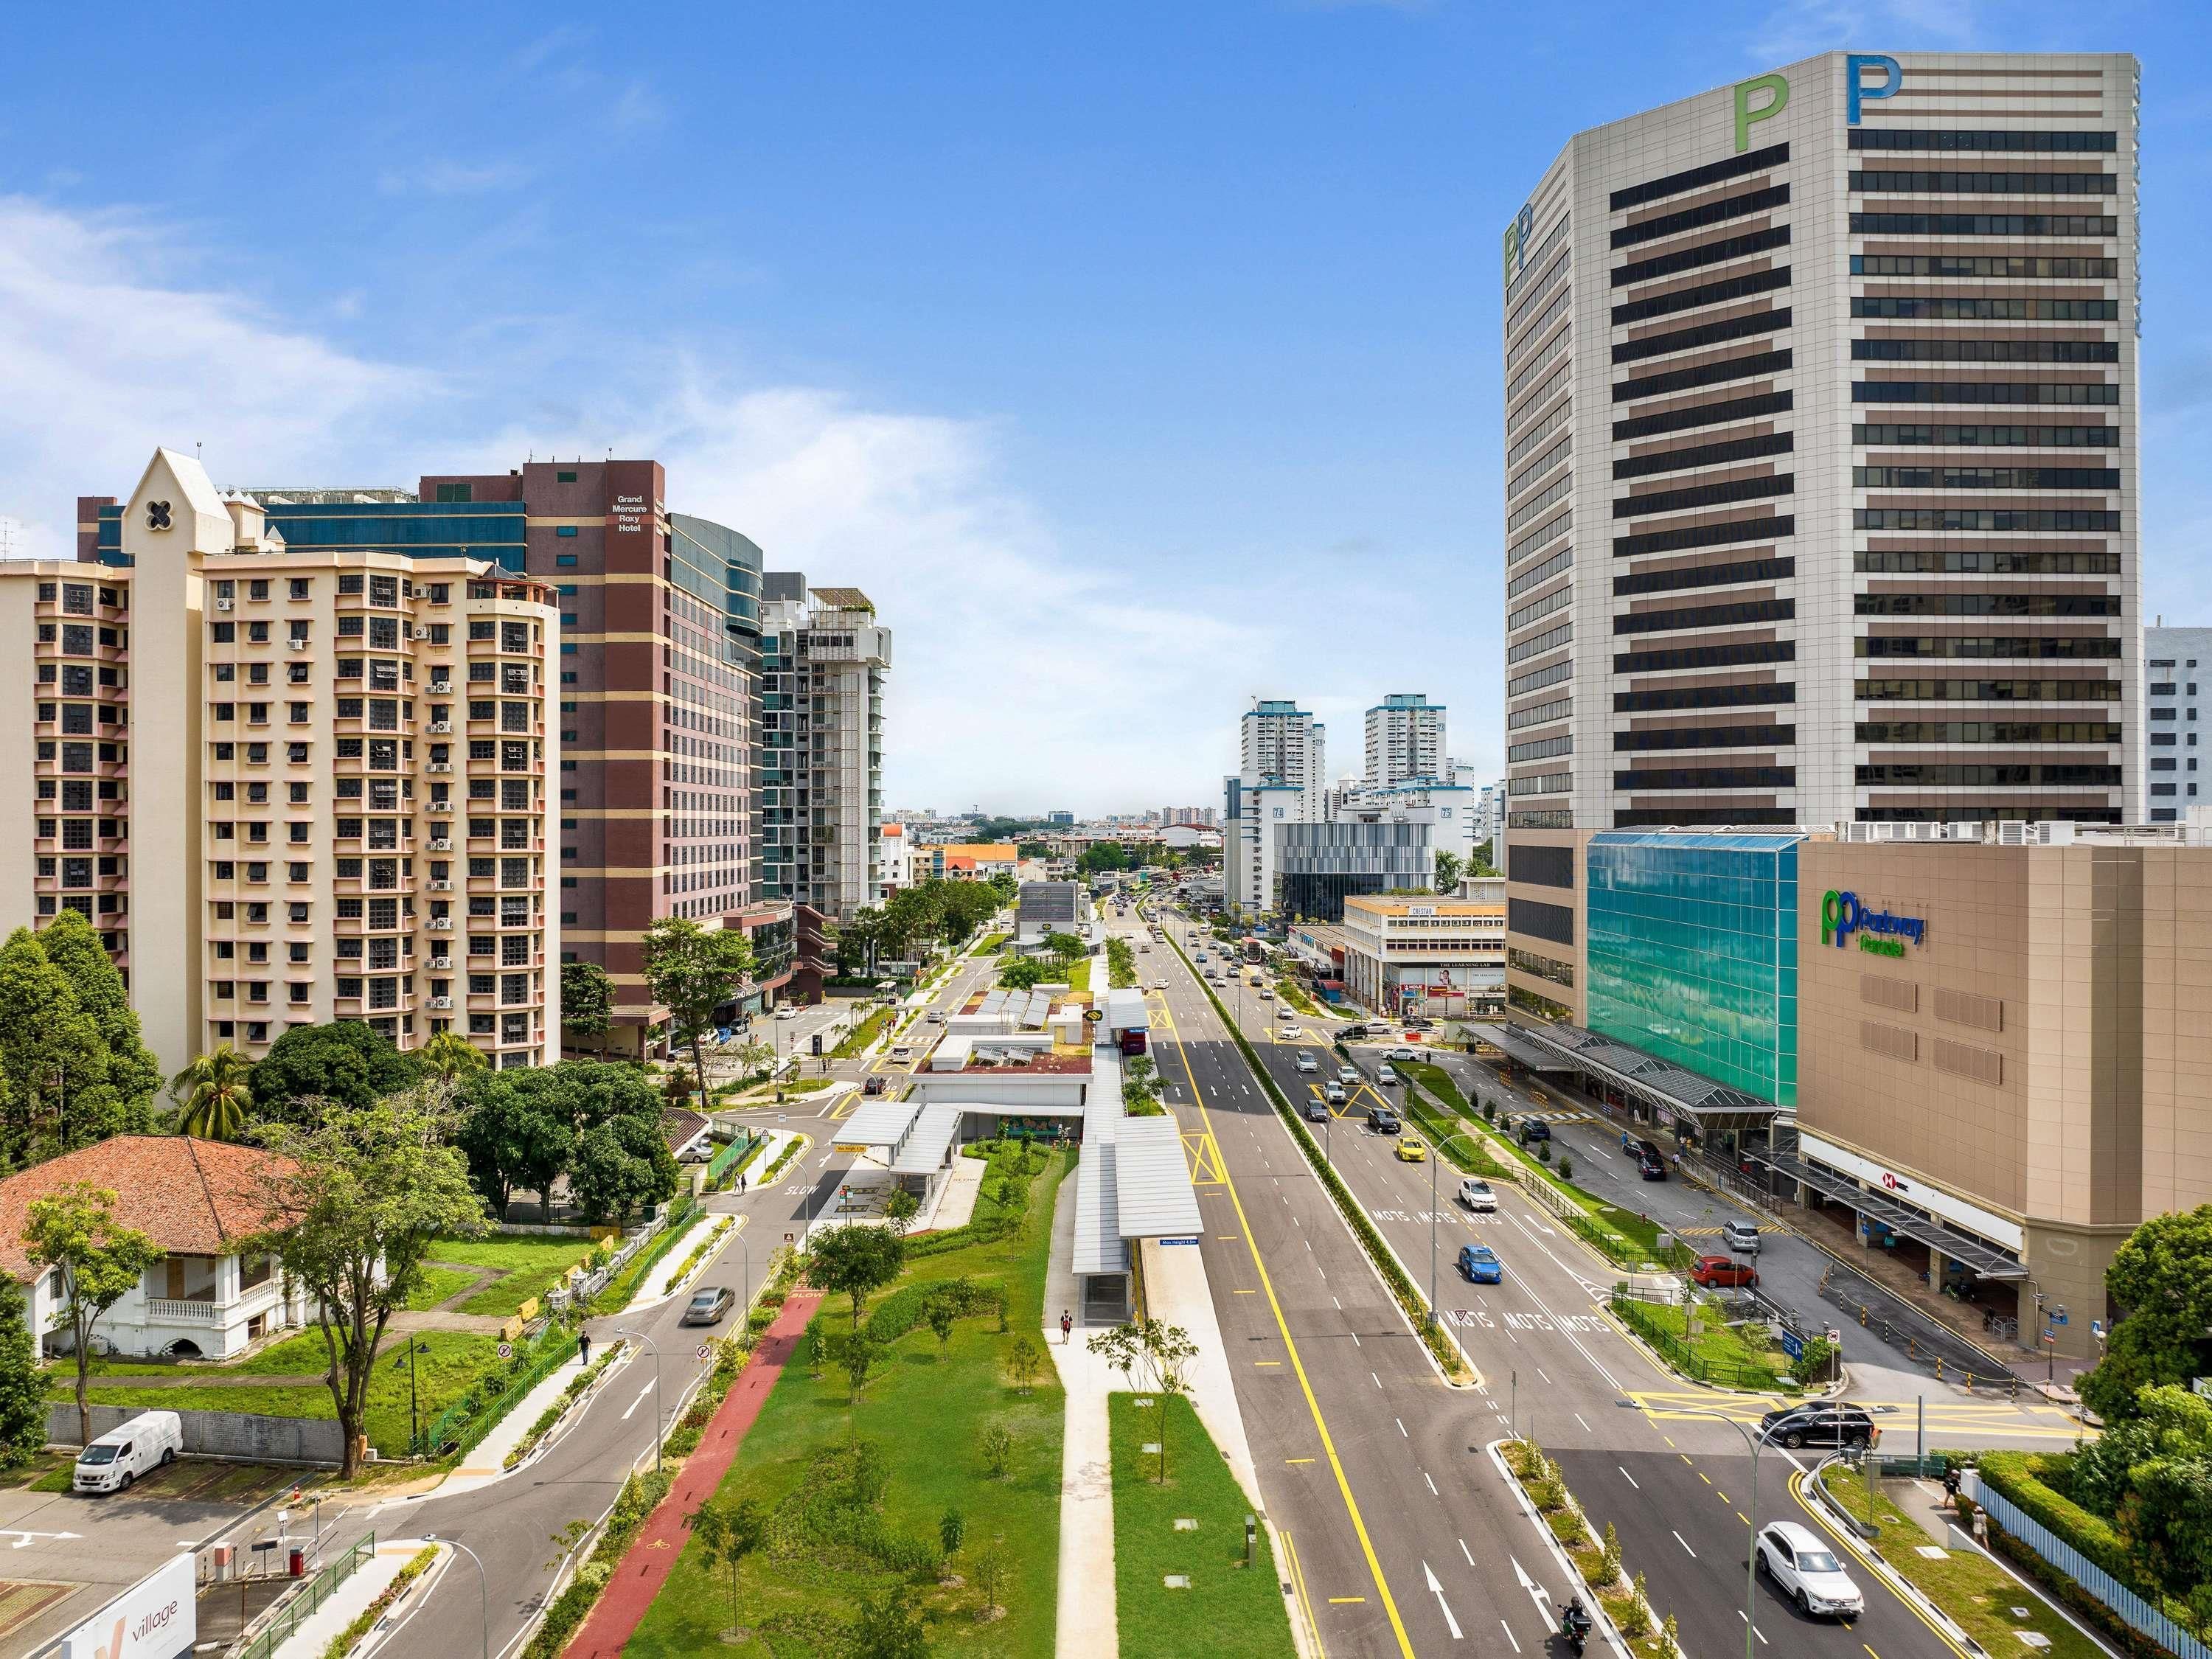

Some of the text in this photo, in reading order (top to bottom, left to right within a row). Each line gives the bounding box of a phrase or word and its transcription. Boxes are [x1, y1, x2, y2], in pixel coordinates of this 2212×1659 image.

[1846, 54, 1902, 125] P
[1734, 74, 1790, 153] P
[619, 515, 640, 524] Roxy
[1274, 809, 1283, 817] 74
[1442, 809, 1450, 817] 75
[1860, 907, 1925, 945] Parkway
[1859, 933, 1904, 958] Parade
[784, 1185, 820, 1194] SLOW
[1372, 1209, 1503, 1225] SLOW SLOW SLOW
[1502, 1312, 1554, 1330] SLOW
[1559, 1315, 1611, 1332] SLOW
[132, 1599, 178, 1642] village
